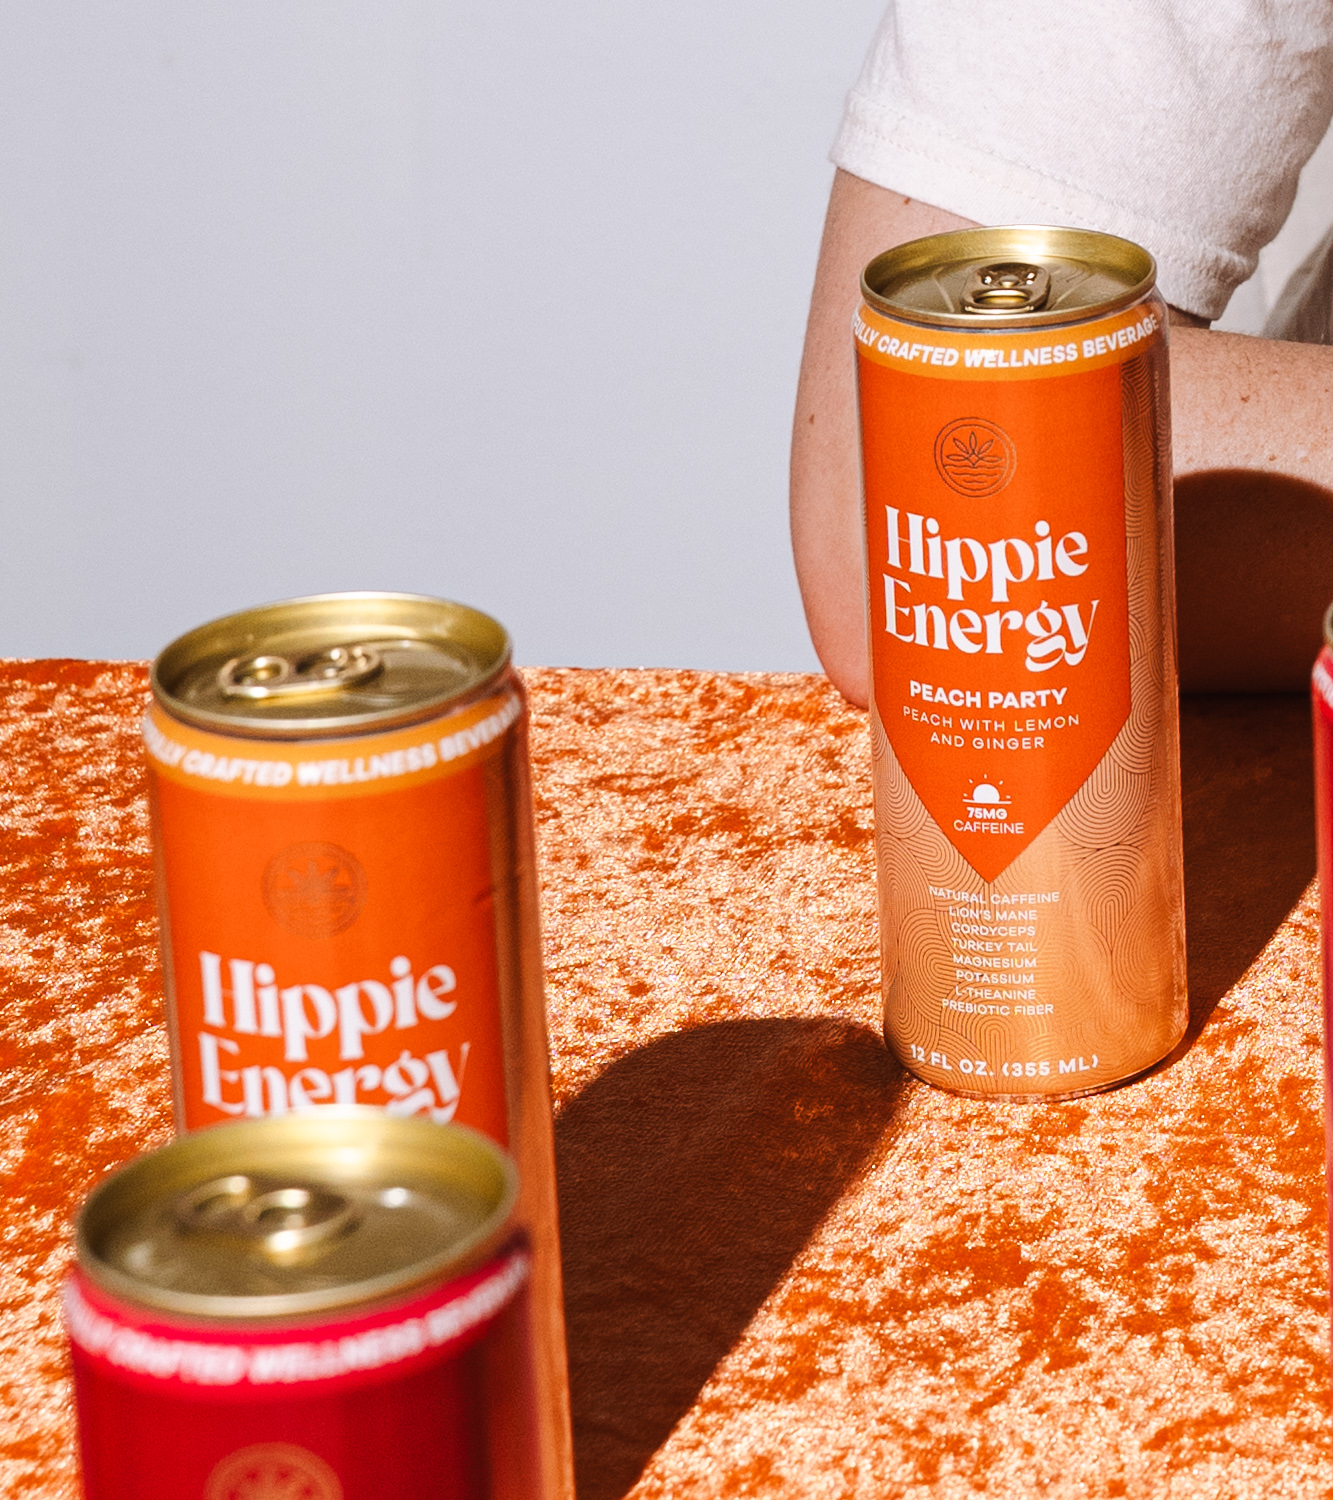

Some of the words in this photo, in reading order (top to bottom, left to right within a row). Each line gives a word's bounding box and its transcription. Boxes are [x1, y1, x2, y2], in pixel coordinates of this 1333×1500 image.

[877, 334, 959, 367] CRAFTED
[964, 342, 1078, 368] WELLNESS
[1083, 313, 1160, 359] BEVERAGE
[885, 505, 1089, 602] Hippie
[883, 573, 1100, 672] Energy
[909, 680, 982, 709] PEACH
[988, 687, 1068, 710] PARTY
[903, 705, 951, 728] PEACH
[960, 718, 1005, 732] WITH
[1014, 713, 1080, 732] LEMON
[930, 731, 965, 749] AND
[972, 735, 1045, 751] GINGER
[967, 807, 1008, 820] 75MG
[953, 819, 1024, 835] CAFFEINE
[929, 885, 987, 904] NATURAL
[990, 891, 1060, 904] CAFFEINE
[949, 906, 993, 920] LION'S
[996, 910, 1037, 920] MANE
[951, 921, 1036, 937] CORDYCEPS
[951, 937, 1003, 951] TURKEY
[1007, 940, 1037, 952] TAIL
[952, 954, 1037, 968] MAGNESIUM
[955, 971, 1034, 984] POTASSIUM
[955, 987, 1036, 1000] L-THEANINE
[200, 951, 457, 1062] Hippie
[941, 999, 1011, 1015] PREBIOTIC
[1014, 1003, 1054, 1015] FIBER
[910, 1044, 927, 1061] 12
[930, 1051, 952, 1070] FL
[959, 1058, 994, 1076] OZ.
[1002, 1061, 1051, 1077] (355
[1058, 1054, 1098, 1074] ML)
